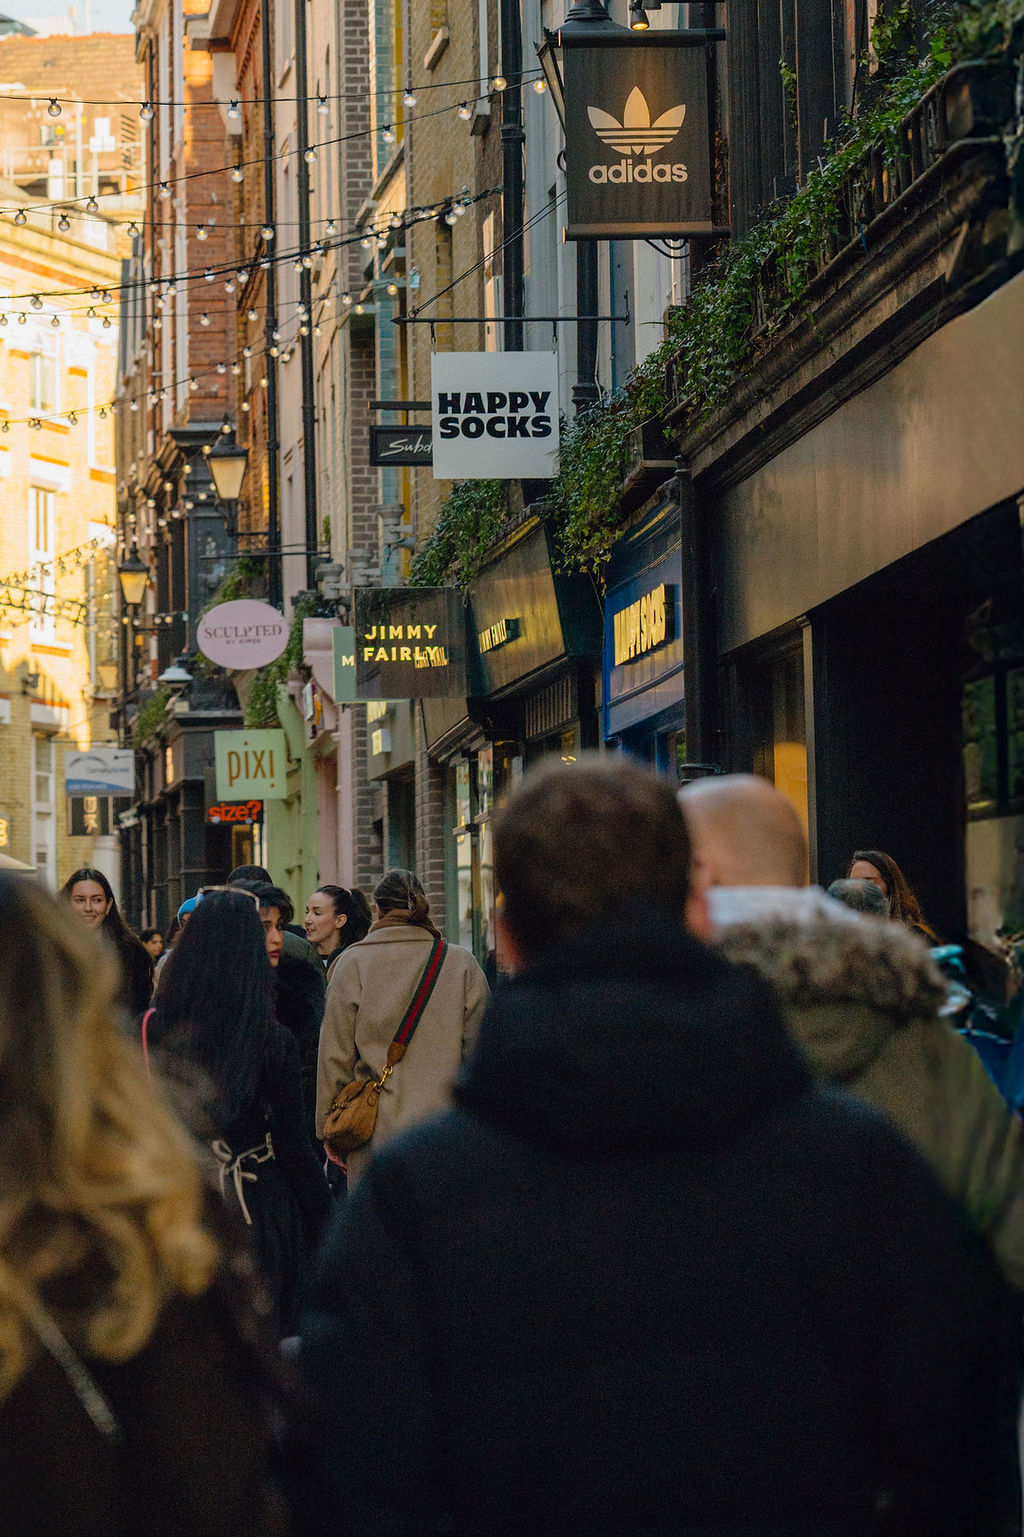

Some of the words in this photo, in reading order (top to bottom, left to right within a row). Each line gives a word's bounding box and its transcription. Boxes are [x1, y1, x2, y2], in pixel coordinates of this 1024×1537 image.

[588, 158, 688, 184] adidas
[437, 391, 552, 414] HAPPY
[439, 415, 552, 439] SOCKS
[204, 624, 282, 639] SCULPTED
[365, 624, 438, 640] JIMMY
[363, 646, 439, 662] FAIRLY
[208, 800, 262, 822] size?
